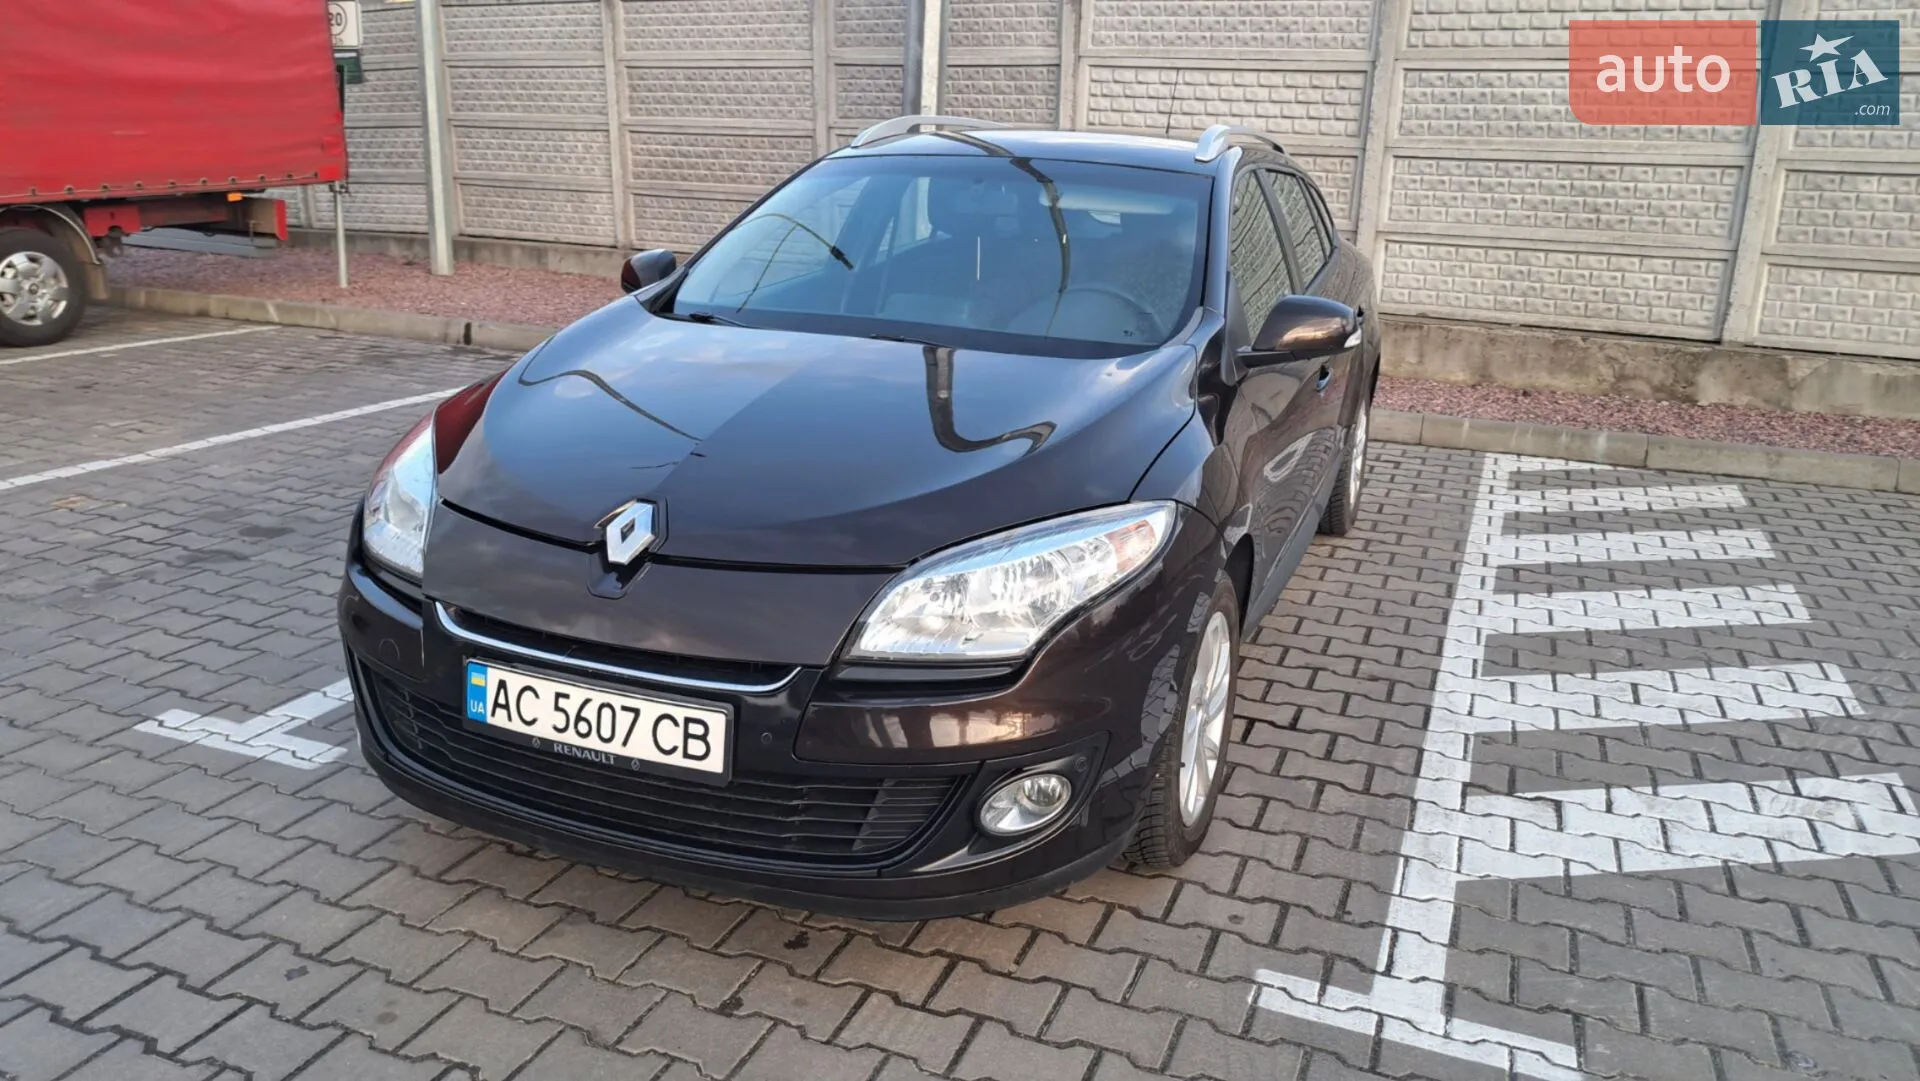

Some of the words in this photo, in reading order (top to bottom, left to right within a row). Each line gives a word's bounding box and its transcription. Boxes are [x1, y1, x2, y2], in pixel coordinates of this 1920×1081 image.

[470, 699, 485, 715] UA
[490, 678, 540, 727] AC
[551, 691, 641, 749] 5607
[651, 713, 712, 762] CB
[552, 742, 617, 766] RENAULT
